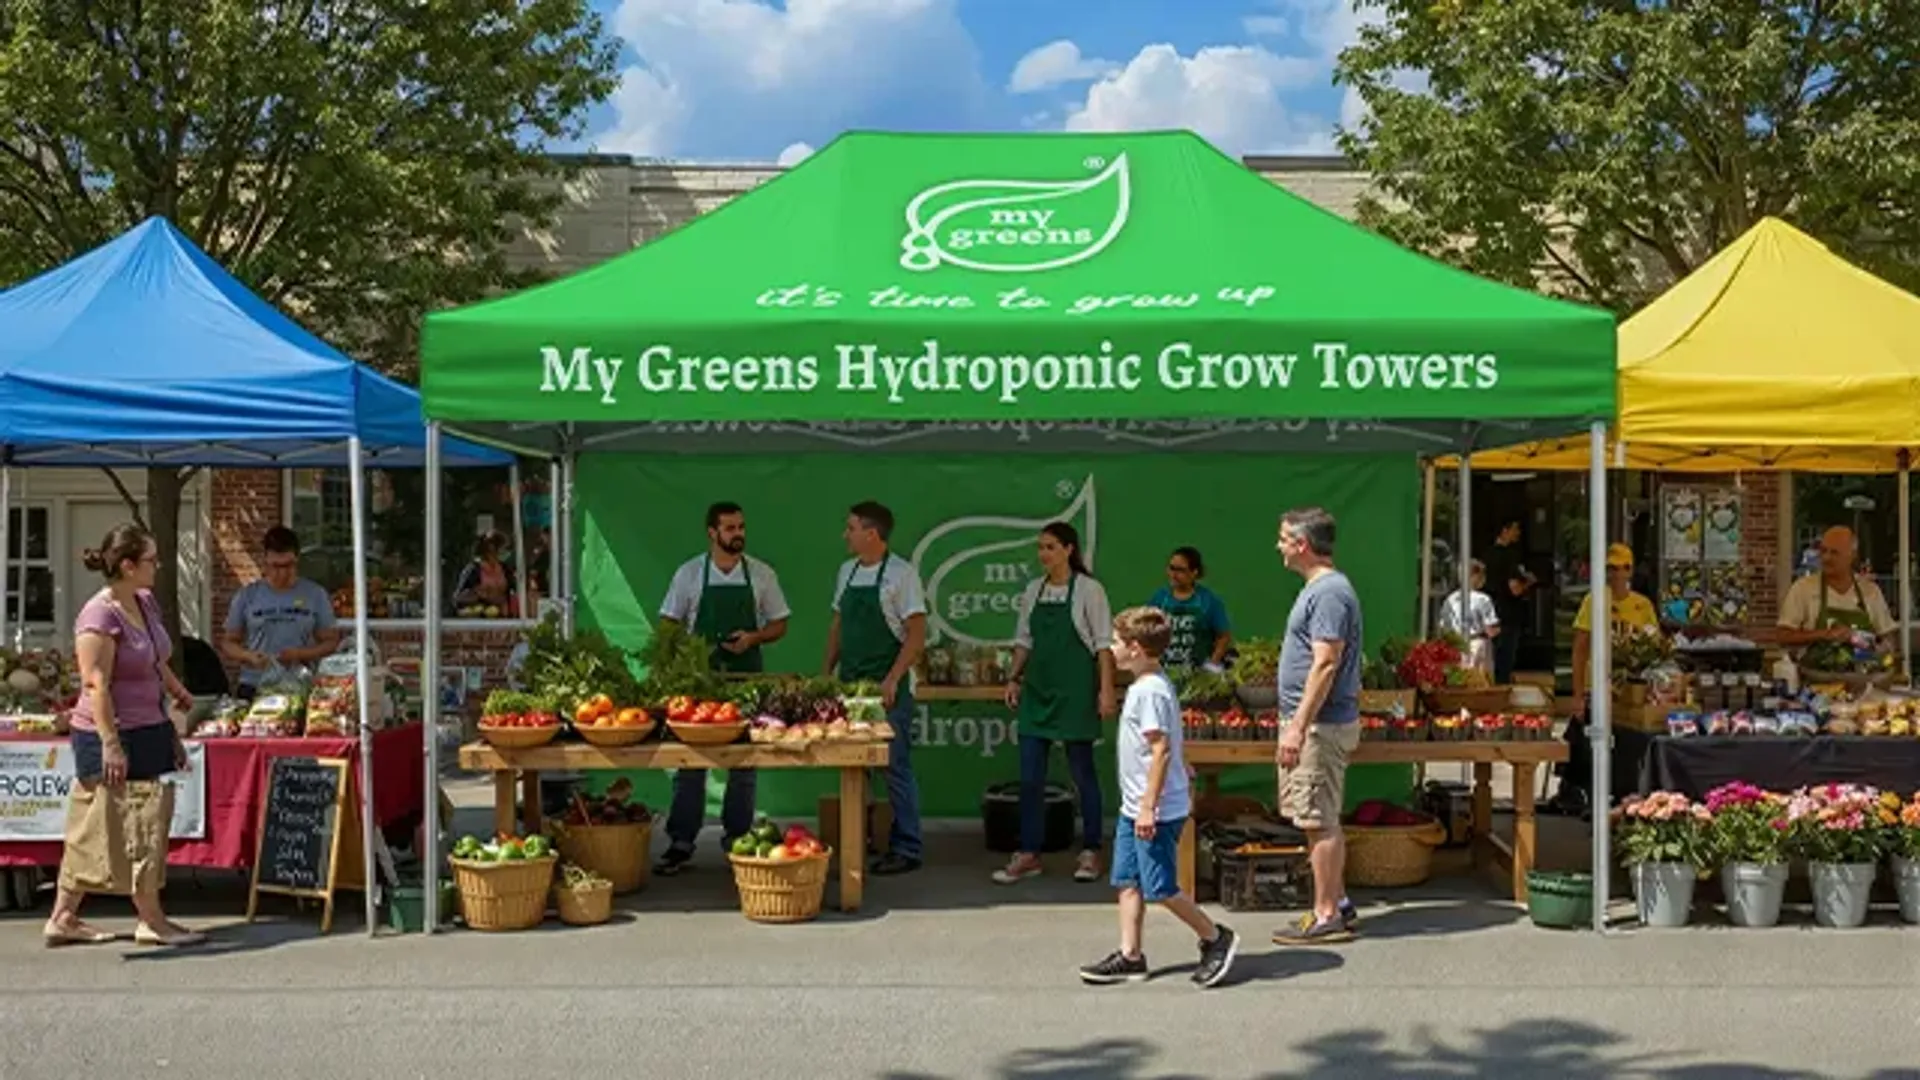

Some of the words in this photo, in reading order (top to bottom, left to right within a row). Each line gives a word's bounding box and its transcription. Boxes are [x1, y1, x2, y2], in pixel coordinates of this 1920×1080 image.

[990, 209, 1055, 230] my
[948, 226, 1094, 249] greens
[755, 284, 842, 307] it's
[868, 287, 975, 307] time
[997, 287, 1051, 308] to
[1065, 293, 1200, 315] grow
[1217, 286, 1276, 306] up
[540, 347, 623, 403] My
[638, 345, 818, 391] Greens
[835, 340, 1142, 402] Hydroponic
[1158, 343, 1298, 389] Grow
[1313, 343, 1498, 389] Towers
[948, 592, 1021, 619] gree
